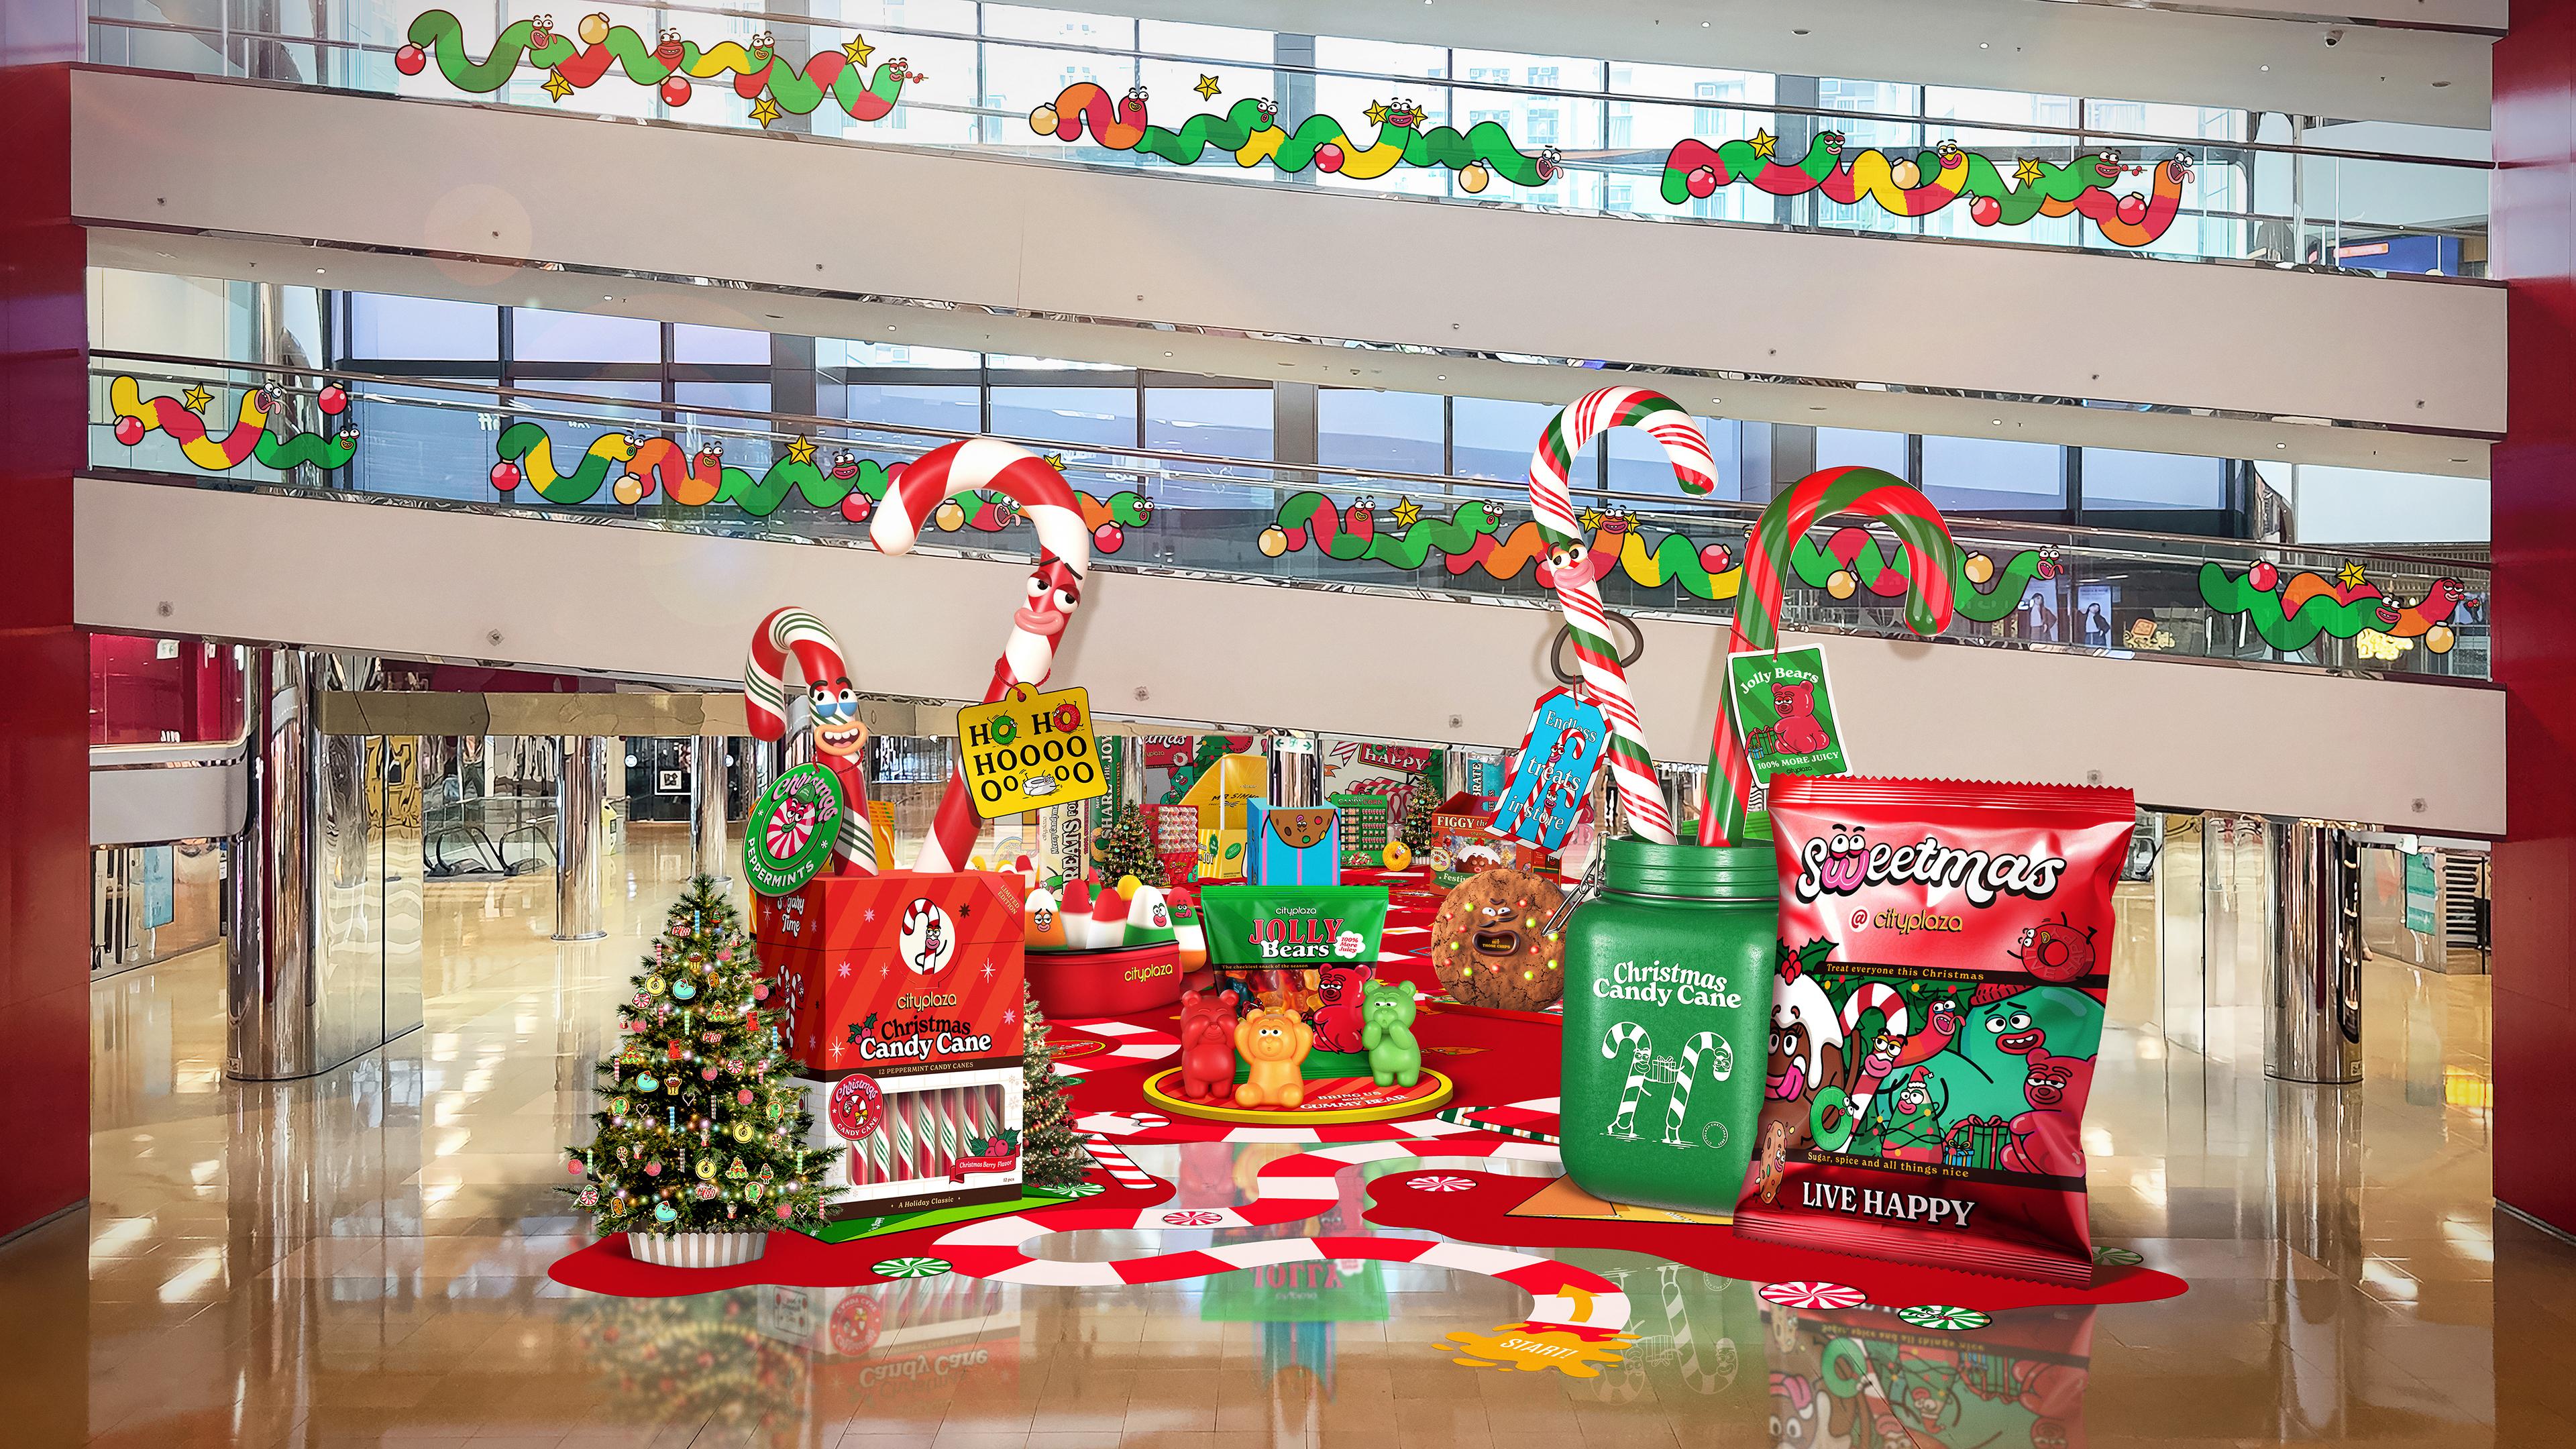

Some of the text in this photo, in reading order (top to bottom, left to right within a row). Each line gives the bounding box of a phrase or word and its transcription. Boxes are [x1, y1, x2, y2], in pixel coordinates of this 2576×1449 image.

[1740, 667, 1819, 694] Jolly Bears
[1545, 710, 1597, 743] Endless
[973, 736, 1087, 776] HOOOO
[1102, 735, 1114, 763] JOY
[1364, 748, 1427, 771] HAPPY
[1757, 751, 1839, 769] 100% MORE JUICY
[1527, 756, 1581, 791] treats
[1786, 765, 1813, 774] cityplaza
[771, 771, 838, 823] Christmas
[1437, 816, 1474, 828] FIGGY
[1508, 796, 1525, 814] in
[1523, 805, 1564, 830] store
[1050, 804, 1059, 854] Merry Candyma
[747, 837, 815, 887] PEPPERMINTS
[1203, 852, 1214, 864] JOY
[1796, 834, 2067, 909] Sweetmas
[998, 891, 1018, 914] EDITION
[1000, 885, 1020, 908] LIMITED
[1276, 906, 1316, 916] cityplaza
[1850, 909, 1963, 934] @ cityplaza
[782, 914, 801, 936] Time
[1248, 918, 1344, 944] JOLLY
[1260, 939, 1330, 958] Bears
[1124, 963, 1173, 982] cityplaza
[1613, 960, 1727, 992] Christmas
[1827, 963, 1984, 980] Treat everyone this Christmas
[897, 991, 957, 1012] cityplaza
[1593, 977, 1741, 1008] Candy Cane
[881, 1015, 971, 1040] Christmas
[860, 1032, 992, 1060] Candy Cane
[887, 1066, 928, 1074] PEPPERMINT
[930, 1063, 951, 1071] CANDY
[835, 1079, 878, 1103] Christmas
[1300, 1095, 1409, 1109] GUMMY BEAR
[837, 1116, 878, 1136] CANDY CANE
[1711, 1124, 1726, 1138] CHRISTMAS
[1807, 1152, 1969, 1177] Sugar, spice and all things nice
[905, 1199, 930, 1208] Holiday
[931, 1197, 954, 1205] Classic
[1803, 1181, 1975, 1226] LIVE HAPPY
[1500, 1338, 1578, 1358] START!
